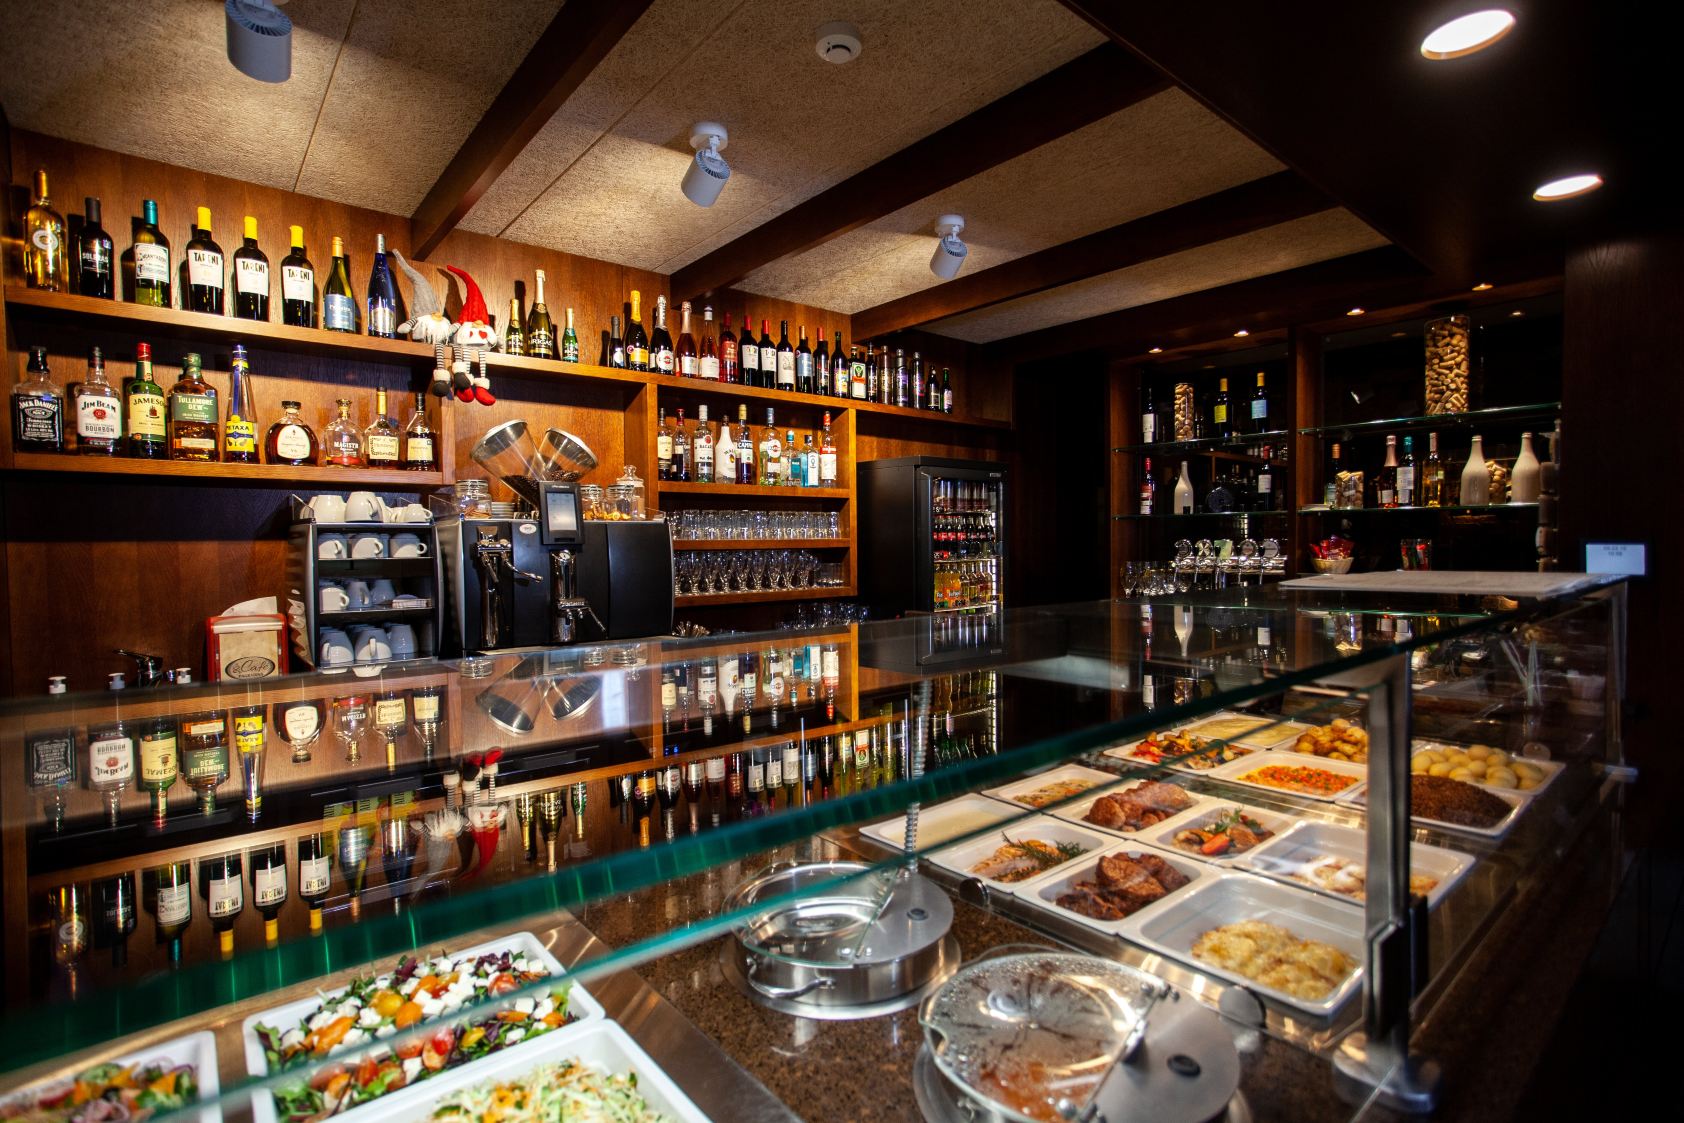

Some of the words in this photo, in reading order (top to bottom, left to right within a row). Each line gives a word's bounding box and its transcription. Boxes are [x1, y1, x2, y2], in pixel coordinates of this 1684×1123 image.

[178, 395, 214, 405] TULLAMORE
[82, 401, 95, 411] JIM
[96, 400, 116, 412] BEAM
[85, 425, 115, 433] BOURBON
